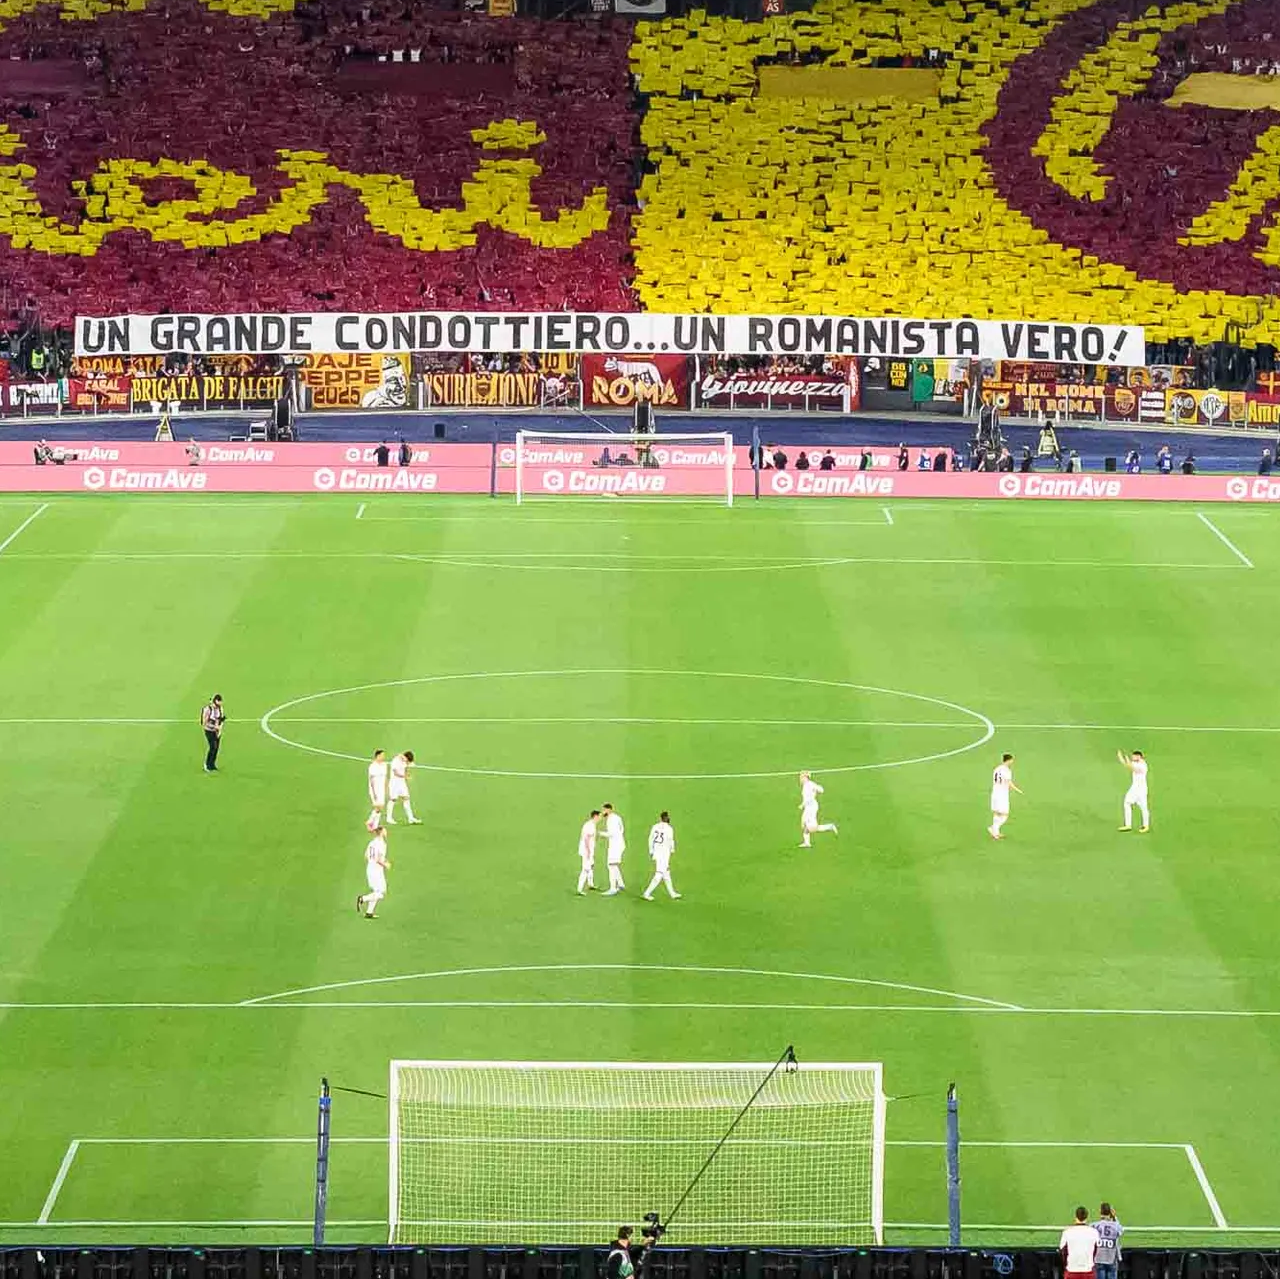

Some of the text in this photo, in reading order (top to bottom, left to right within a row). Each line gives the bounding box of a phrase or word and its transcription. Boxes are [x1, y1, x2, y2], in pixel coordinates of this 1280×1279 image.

[82, 317, 130, 352] UN
[150, 315, 313, 352] GRANDE
[749, 317, 979, 356] ROMANISTA
[1001, 323, 1128, 362] VERO!
[302, 353, 372, 368] DAJE
[131, 375, 285, 402] BRIGATA DE FALCHI
[313, 385, 361, 405] 2025
[591, 375, 679, 406] ROMA
[1014, 383, 1106, 398] NEL NOME
[1023, 398, 1096, 414] DI ROMA
[207, 447, 274, 462] ComAve
[109, 468, 208, 489] ComAve
[339, 469, 438, 490] ComAve
[569, 471, 666, 492] ComAve
[796, 473, 895, 494] ComAve
[1025, 476, 1121, 497] ComAve
[653, 830, 665, 844] 23
